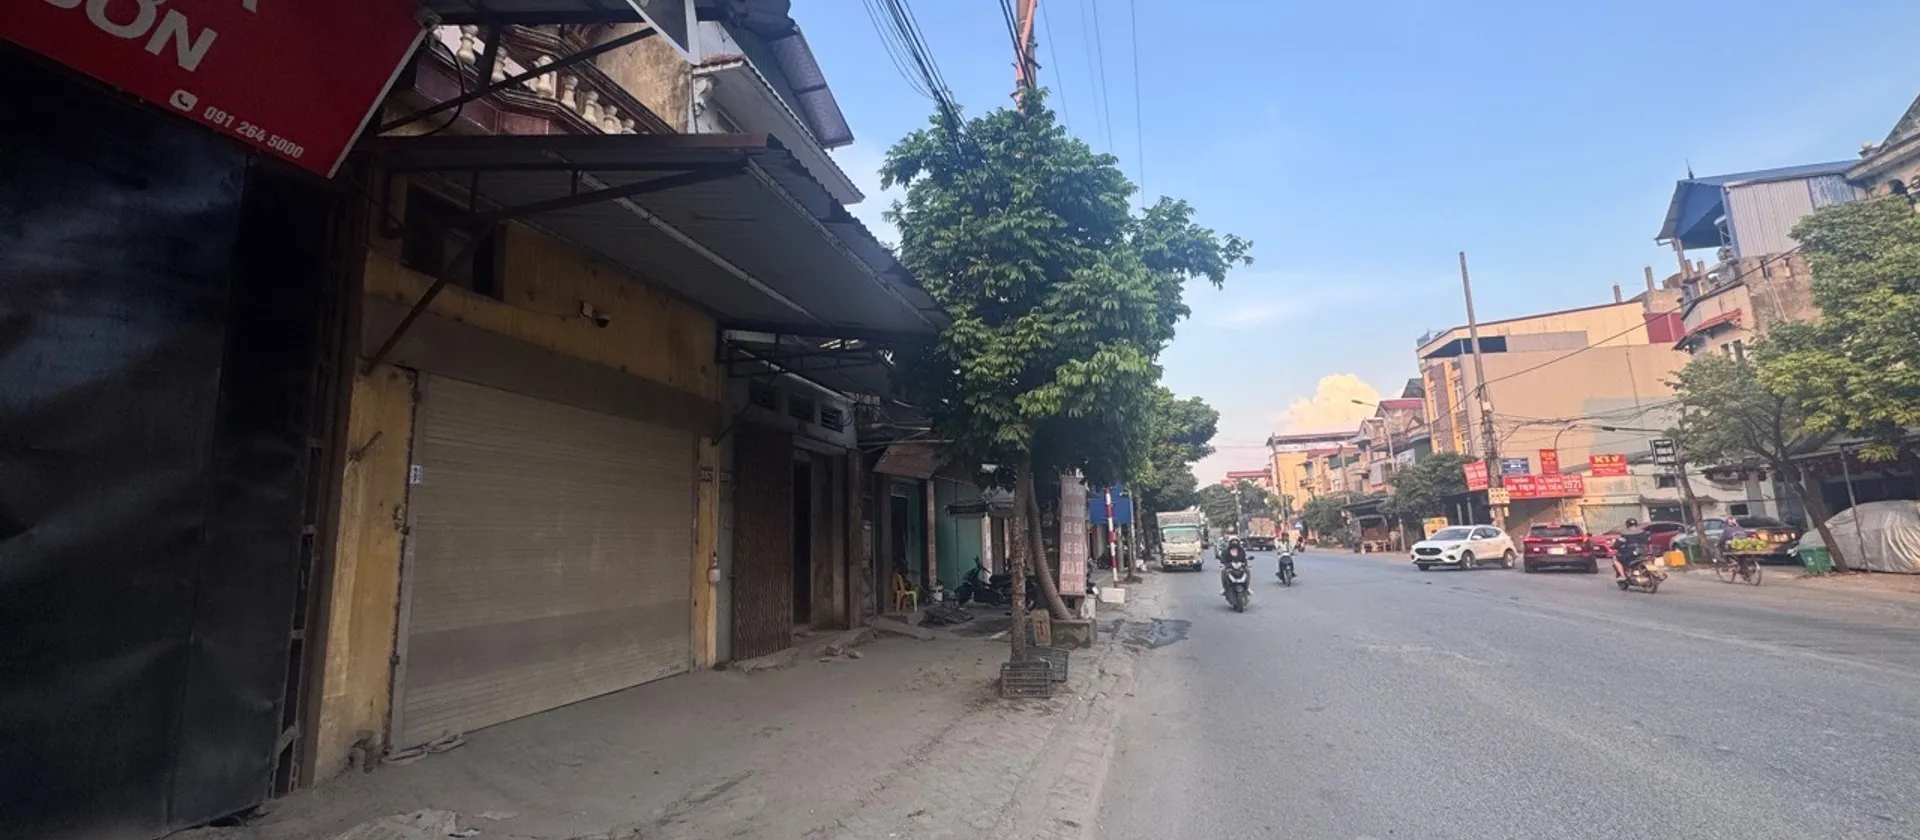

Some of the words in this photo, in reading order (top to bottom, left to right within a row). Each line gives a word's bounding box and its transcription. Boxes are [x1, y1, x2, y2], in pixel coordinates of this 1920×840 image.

[203, 106, 235, 128] 091
[236, 121, 268, 142] 264
[267, 134, 304, 158] 5000
[1594, 455, 1620, 464] KTV
